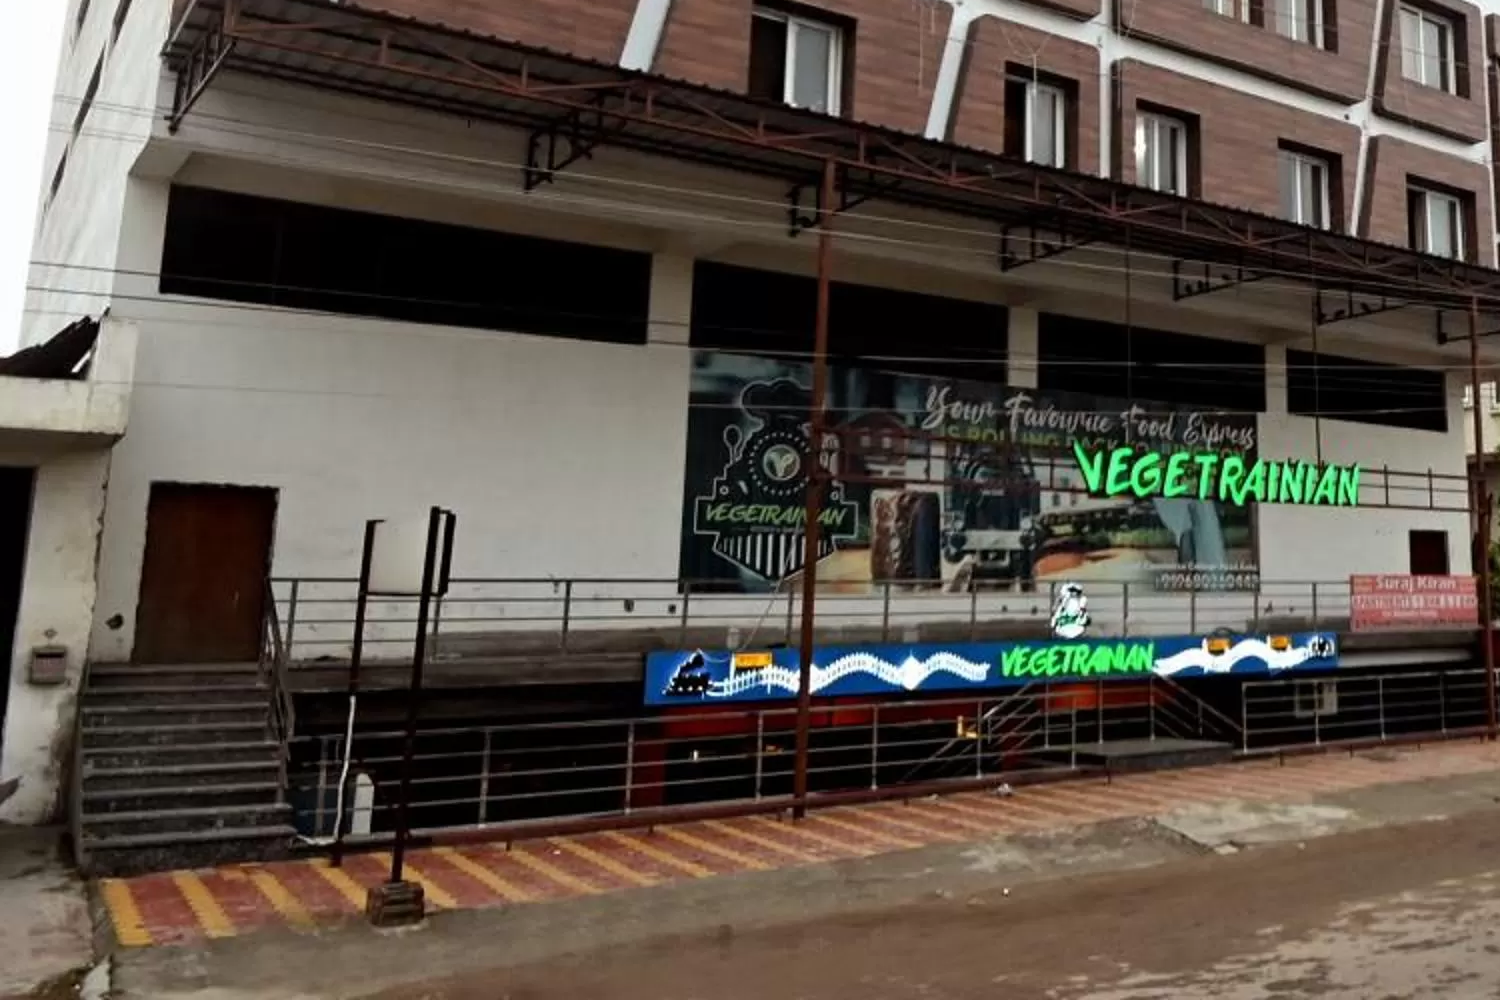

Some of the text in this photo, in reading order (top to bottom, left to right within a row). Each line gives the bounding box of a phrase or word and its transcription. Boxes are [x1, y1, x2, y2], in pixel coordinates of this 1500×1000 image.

[921, 385, 996, 429] Your
[1119, 403, 1174, 443] Food
[1183, 411, 1256, 451] Express
[967, 426, 1059, 447] ROLING
[1073, 440, 1360, 506] VEGETRAINIAN
[705, 503, 848, 527] VEGETRAINAN
[1376, 575, 1457, 593] Suraj Kiran
